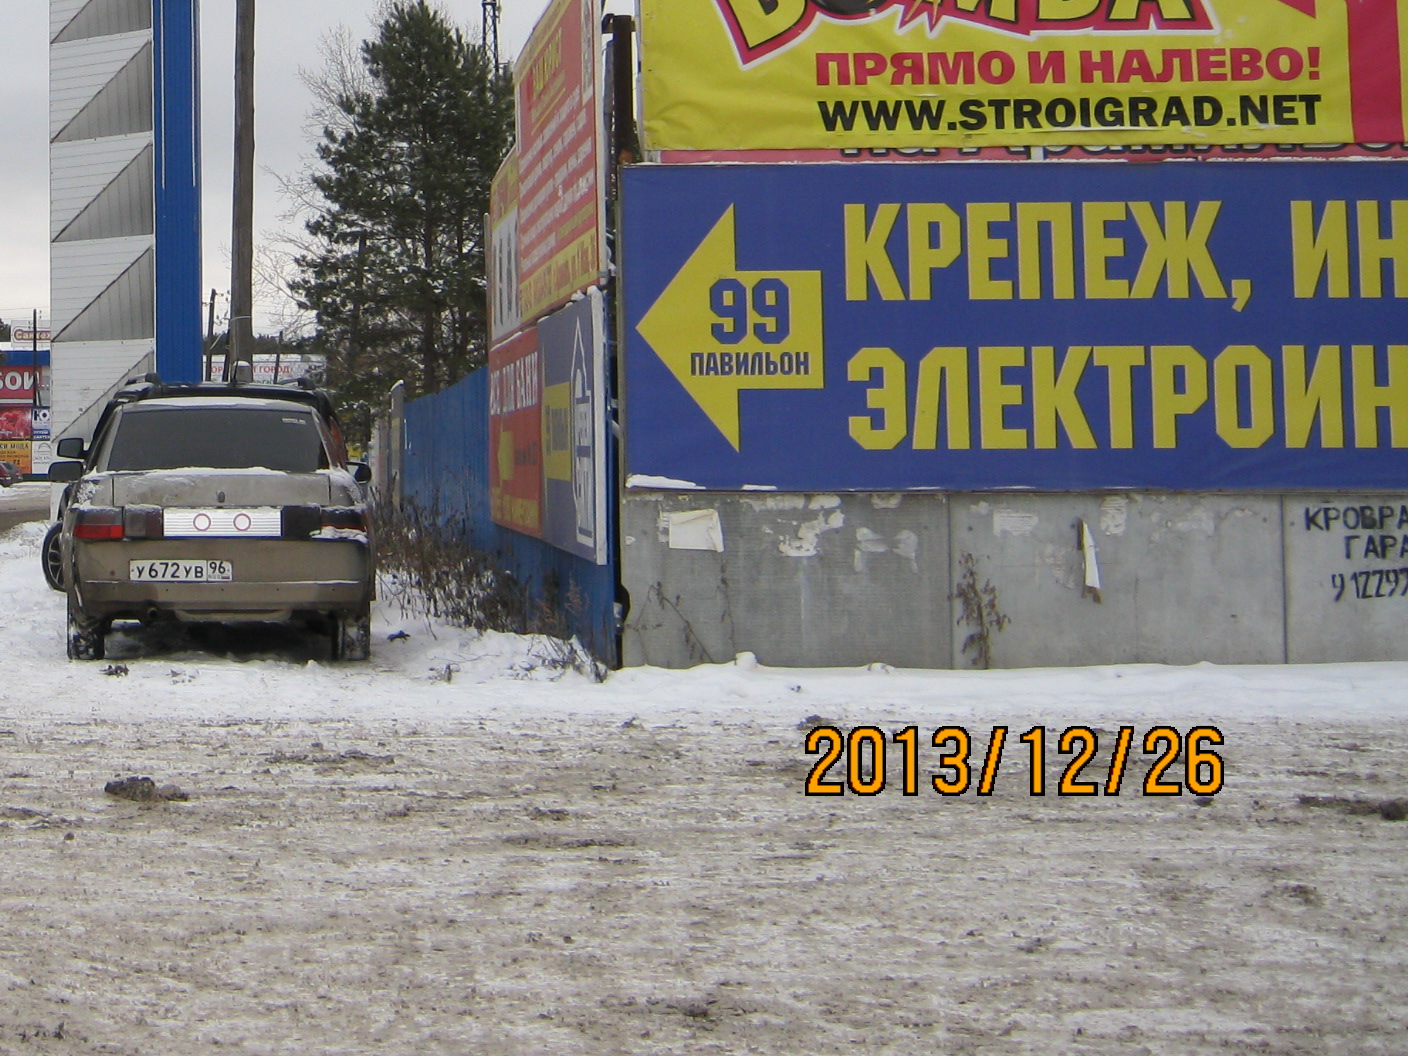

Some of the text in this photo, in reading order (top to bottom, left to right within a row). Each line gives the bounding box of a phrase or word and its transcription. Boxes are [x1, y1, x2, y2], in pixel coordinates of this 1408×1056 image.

[815, 46, 1322, 87] ПРЯМО И НАЛЕВО!
[817, 94, 1322, 132] WWW.STROIGRAD.NET
[843, 200, 1252, 313] КРЕПЕЖ,
[709, 278, 791, 345] 99
[691, 352, 810, 376] ПАВИЛЬОН
[847, 345, 1408, 450] ЭЛЕКТРОИН
[136, 560, 228, 579] У672УВ 96
